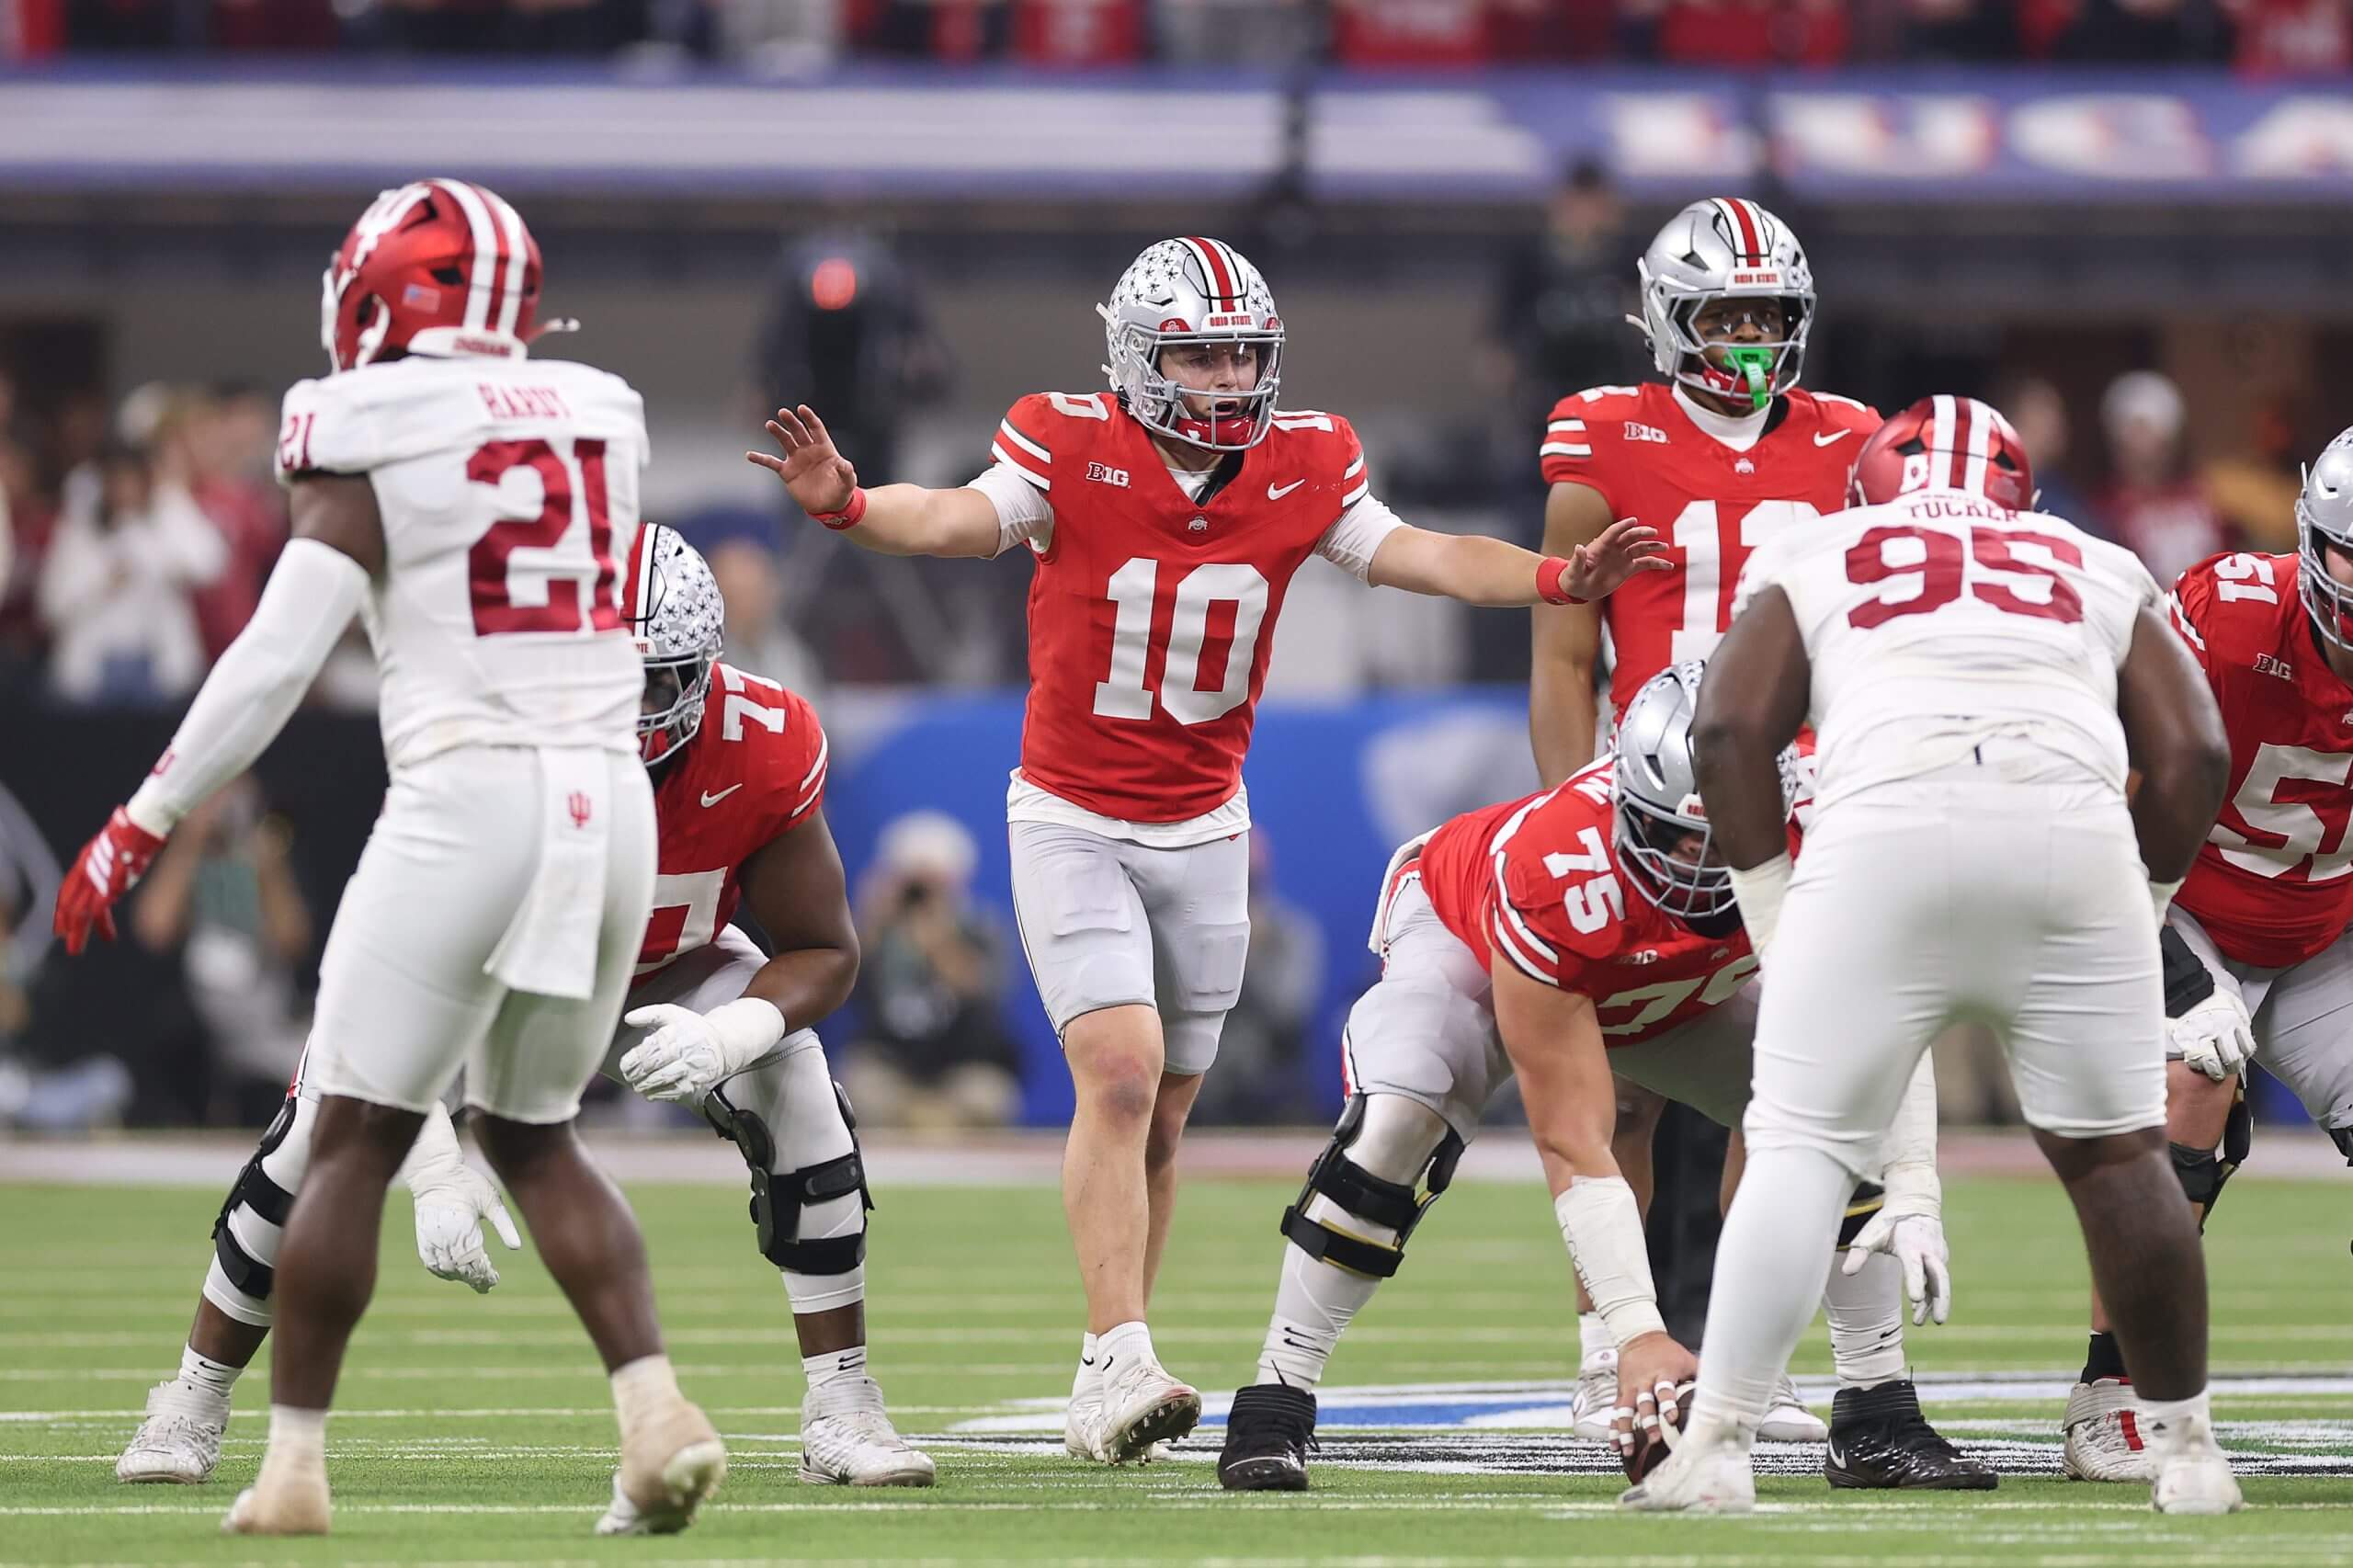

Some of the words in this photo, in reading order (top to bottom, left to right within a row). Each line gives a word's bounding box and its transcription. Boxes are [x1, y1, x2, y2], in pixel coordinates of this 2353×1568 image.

[1210, 316, 1228, 326] OHIO
[1232, 315, 1252, 325] STATE
[280, 413, 316, 471] 21
[466, 437, 626, 638] 21
[1846, 526, 2084, 630] 95
[2214, 551, 2279, 605] 51
[1093, 557, 1269, 726] 10
[1542, 826, 1625, 935] 75
